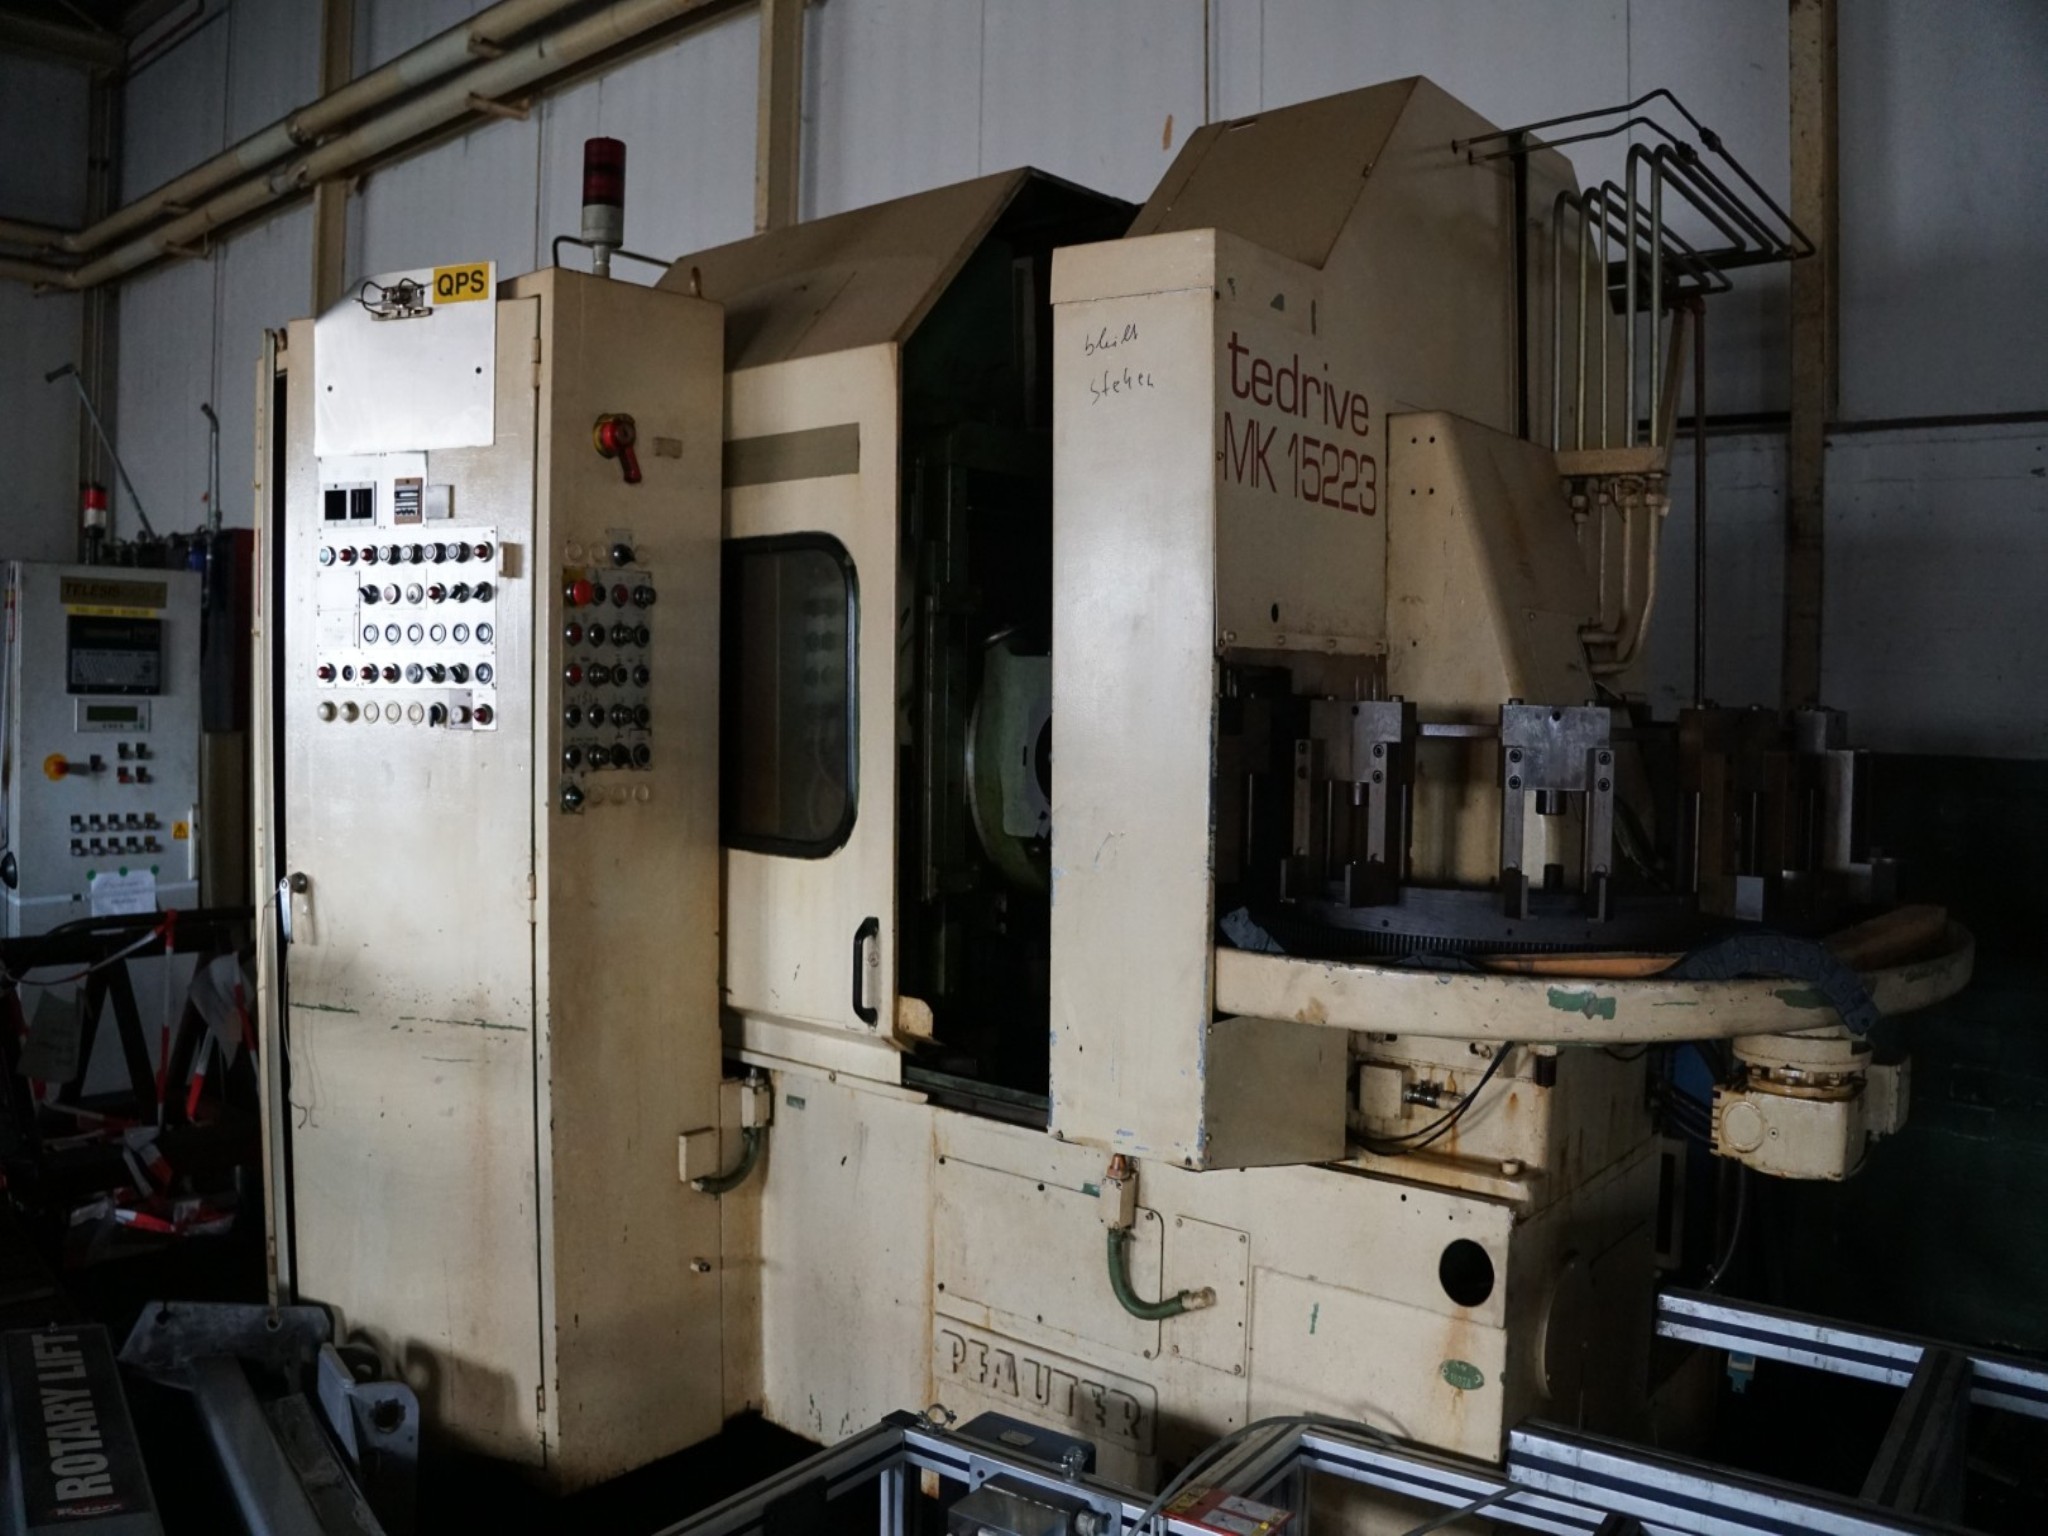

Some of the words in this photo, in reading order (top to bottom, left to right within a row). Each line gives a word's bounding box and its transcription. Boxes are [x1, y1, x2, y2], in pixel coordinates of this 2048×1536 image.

[437, 270, 485, 297] QPS
[1228, 331, 1370, 437] tedrive
[1224, 411, 1278, 494] MK
[1287, 432, 1377, 517] 15223
[31, 1334, 87, 1382] LIFT
[40, 1388, 114, 1501] ROTARY
